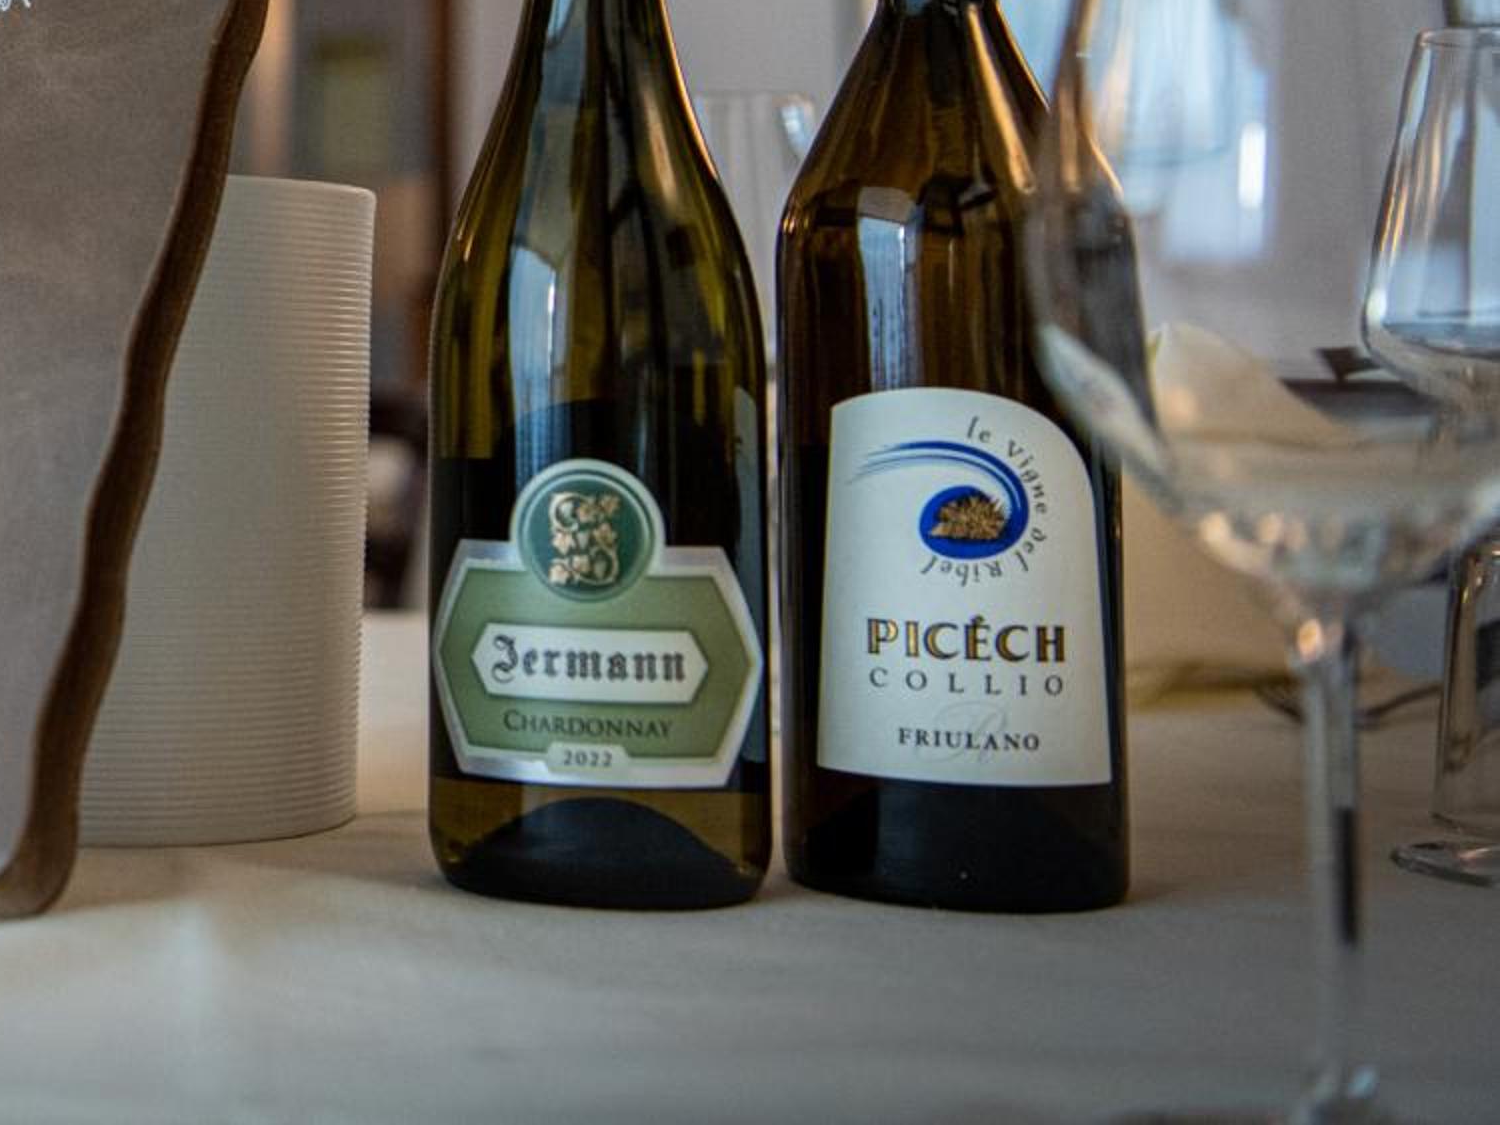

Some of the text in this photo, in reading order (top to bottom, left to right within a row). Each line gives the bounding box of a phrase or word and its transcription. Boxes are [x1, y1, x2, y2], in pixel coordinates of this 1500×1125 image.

[966, 416, 992, 443] le
[1005, 440, 1048, 515] Vigne
[1013, 528, 1048, 573] del
[491, 634, 687, 684] Jermann
[869, 667, 1064, 697] COLLIO
[898, 727, 1040, 752] FRIULANO
[562, 750, 614, 768] 2022
